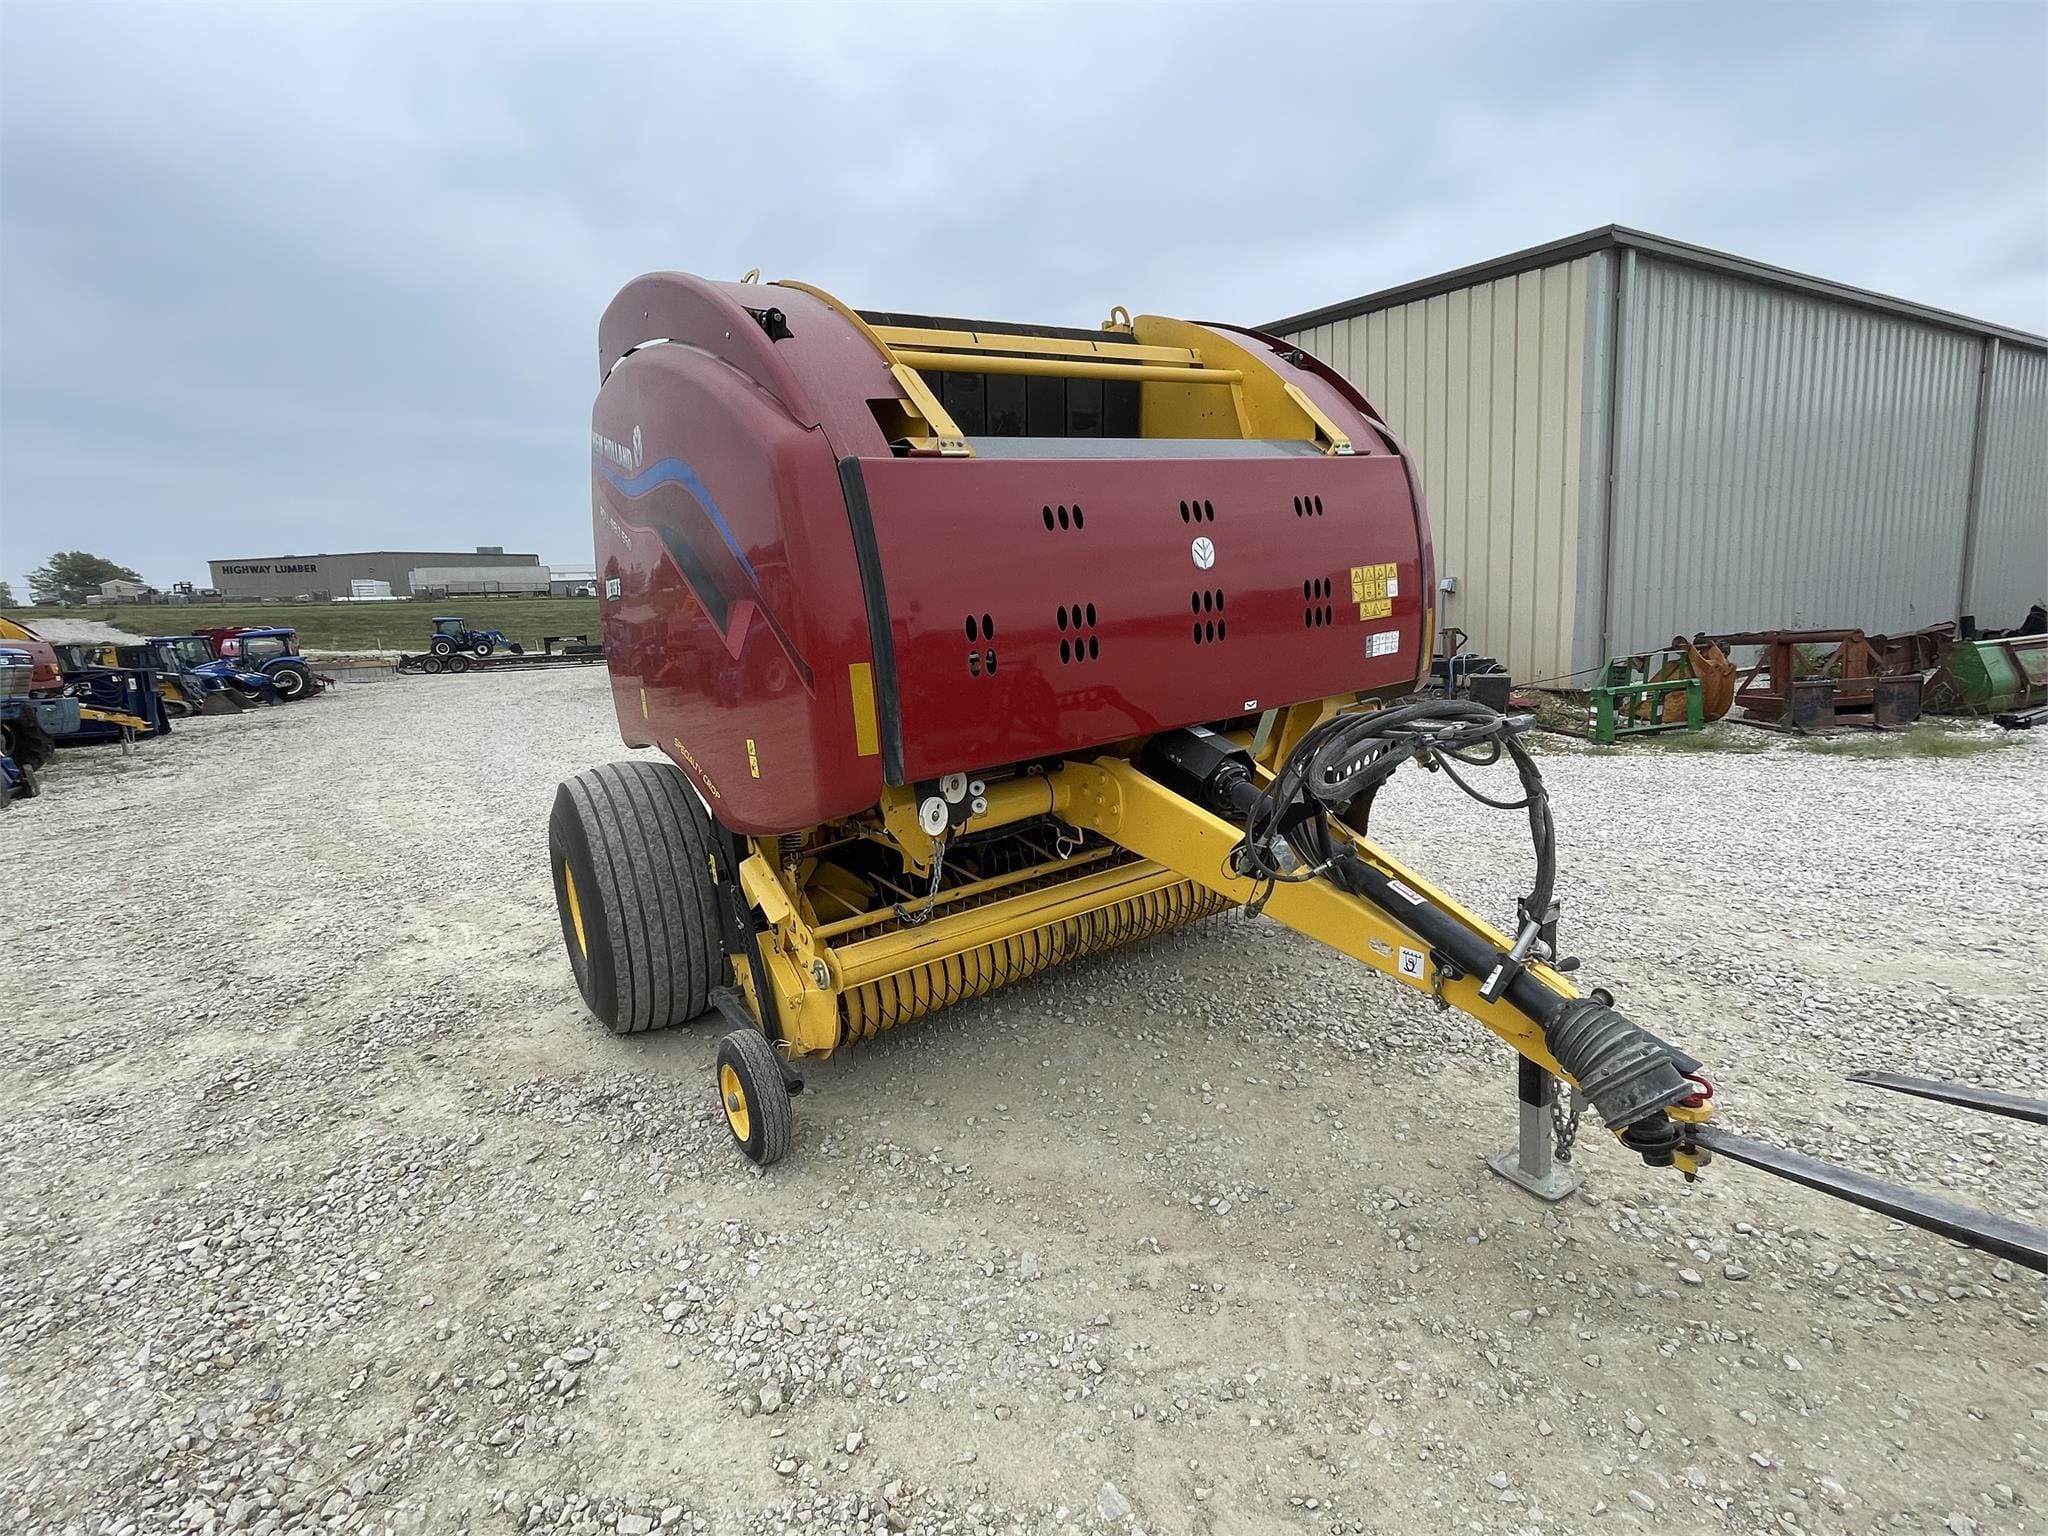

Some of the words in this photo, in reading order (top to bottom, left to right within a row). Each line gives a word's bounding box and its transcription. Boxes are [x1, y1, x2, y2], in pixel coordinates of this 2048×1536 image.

[222, 565, 271, 575] HIGHWAY
[274, 564, 317, 574] LUMBER
[674, 737, 702, 775] SPECIALTY
[702, 774, 721, 799] CROP
